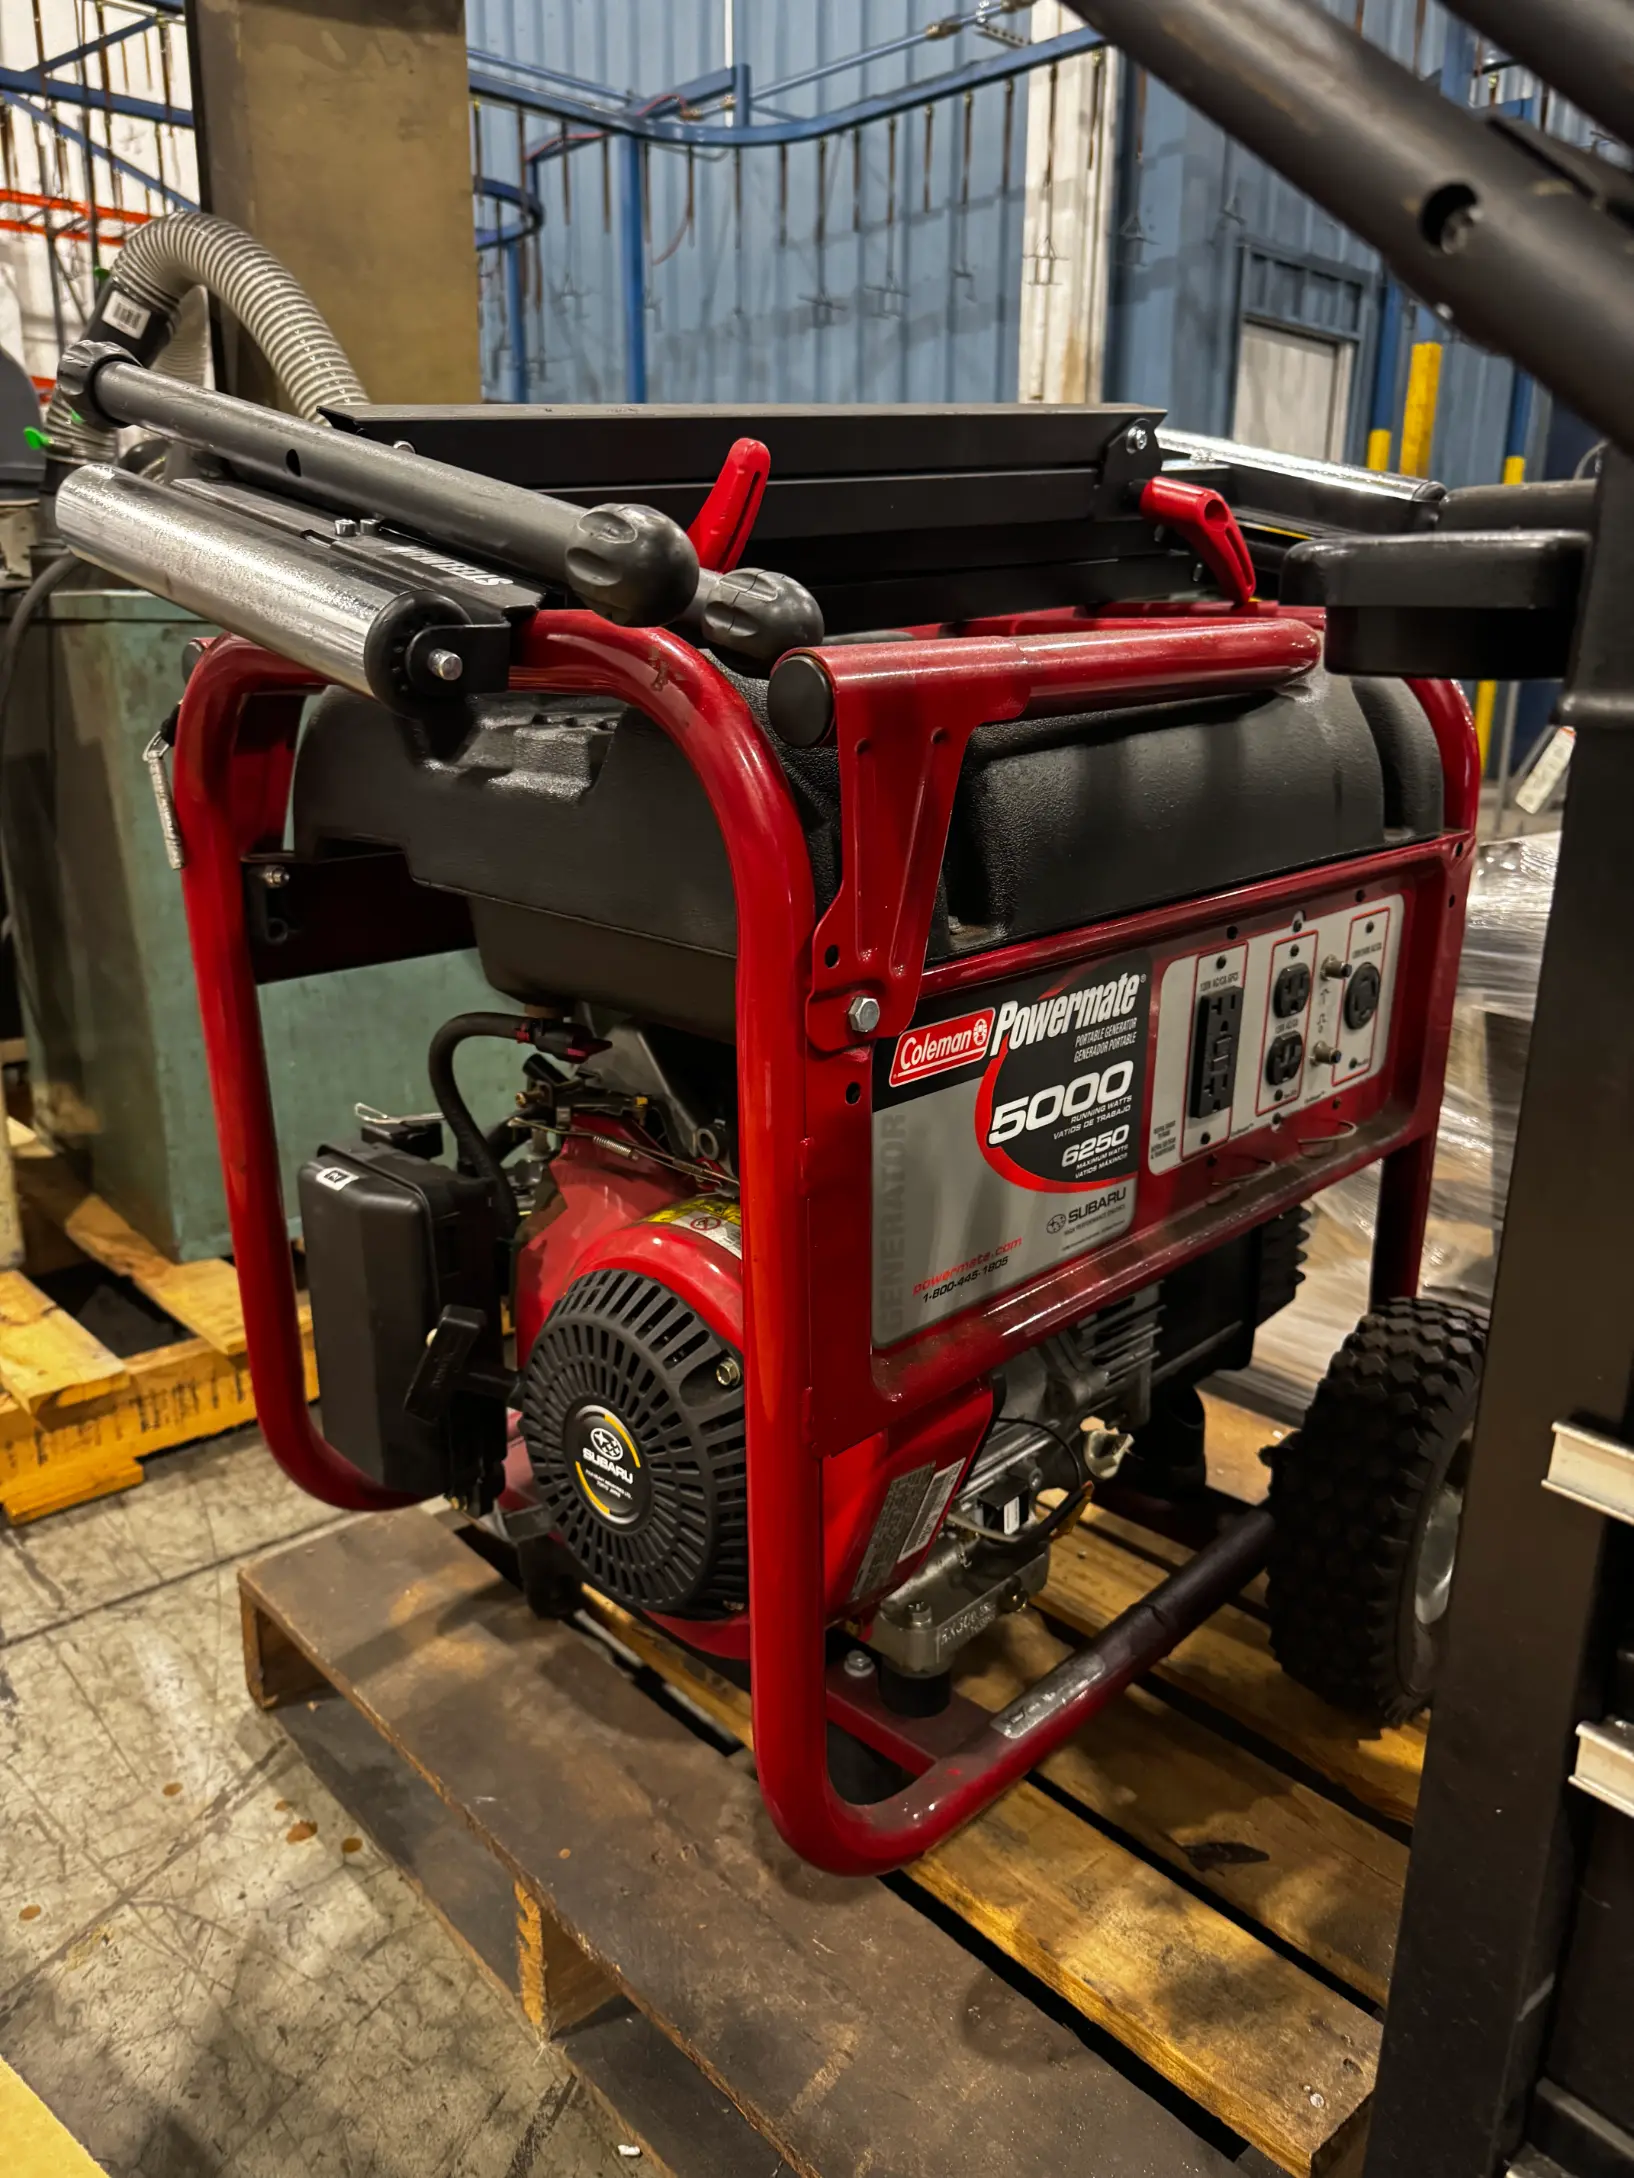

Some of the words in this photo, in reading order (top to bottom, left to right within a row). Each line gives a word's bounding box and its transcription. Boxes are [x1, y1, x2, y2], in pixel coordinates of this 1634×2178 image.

[990, 972, 1140, 1057] Powermate
[1075, 1027, 1105, 1048] PORTABLE
[1105, 1017, 1137, 1038] GENERATOR
[900, 1028, 970, 1070] Coleman
[1074, 1041, 1109, 1063] GENERADOR
[1109, 1031, 1137, 1052] PORTABLE
[989, 1061, 1134, 1145] 5000
[1071, 1105, 1106, 1123] RUNNING
[1107, 1095, 1132, 1109] WATTS
[1053, 1123, 1081, 1140] VATIOS
[1083, 1119, 1094, 1128] DE
[1097, 1105, 1131, 1123] TRABAJO
[1062, 1124, 1130, 1167] 6250
[1076, 1153, 1107, 1170] MAXIMUM
[1108, 1144, 1128, 1157] WATTS
[1075, 1165, 1097, 1179] VATIOS
[1068, 1187, 1126, 1224] SUBARU
[912, 1237, 1023, 1296] powermate.com
[923, 1256, 1009, 1303] 1-800-445-1805
[582, 1447, 633, 1484] SUBARU
